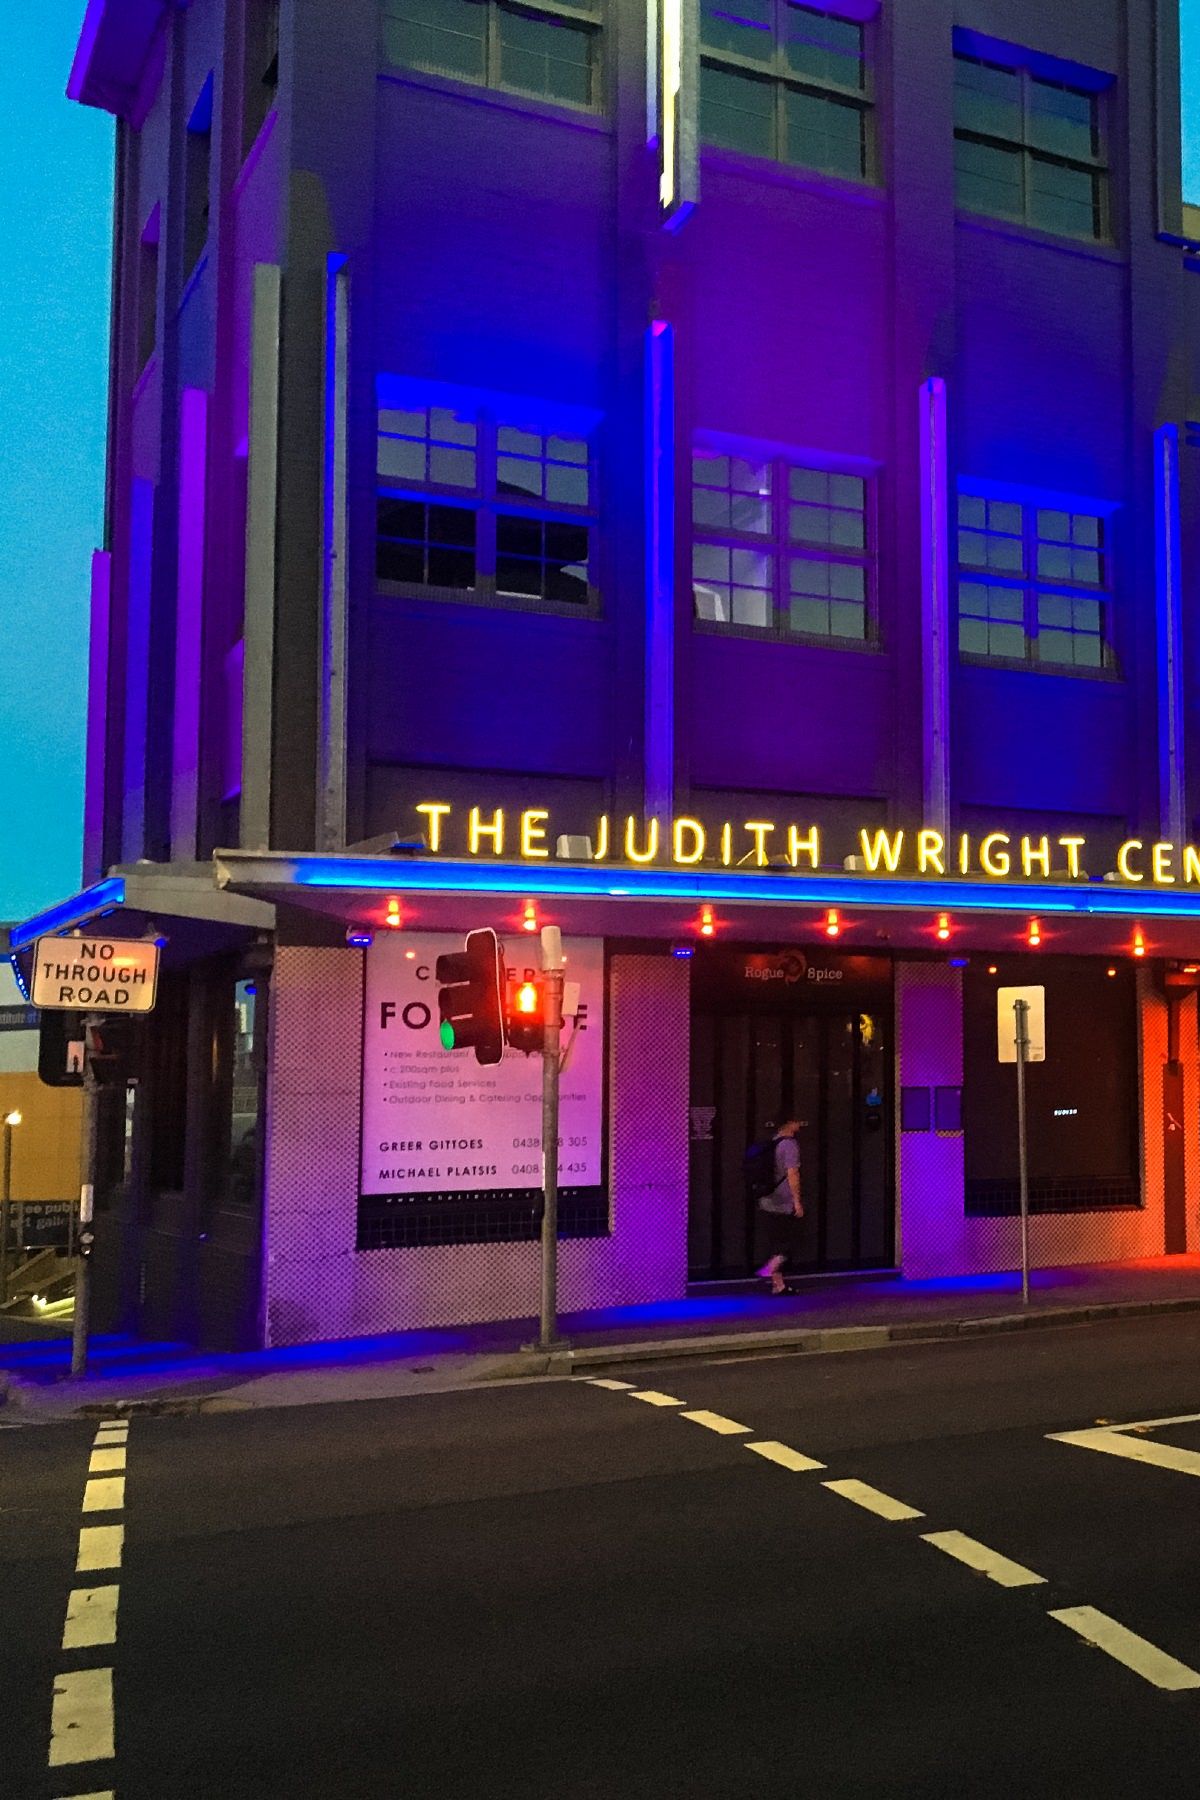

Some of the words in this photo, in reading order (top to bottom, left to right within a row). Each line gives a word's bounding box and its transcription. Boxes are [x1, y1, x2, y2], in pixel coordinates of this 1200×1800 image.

[415, 803, 550, 857] THE
[594, 815, 820, 869] JUDITH
[859, 828, 1086, 879] WRIGHT
[81, 943, 115, 960] NO
[43, 963, 147, 984] THROUGH
[744, 966, 784, 980] Rogue
[59, 986, 130, 1005] ROAD
[389, 1095, 432, 1104] Outdoor
[434, 1094, 466, 1104] Dining
[379, 1142, 423, 1152] GREER
[428, 1139, 484, 1150] GITTOES
[512, 1138, 541, 1148] 0438
[567, 1136, 588, 1146] 305
[378, 1168, 441, 1179] MICHAEL
[446, 1165, 498, 1176] PLATSIS
[511, 1164, 540, 1175] 0408
[566, 1162, 587, 1172] 435
